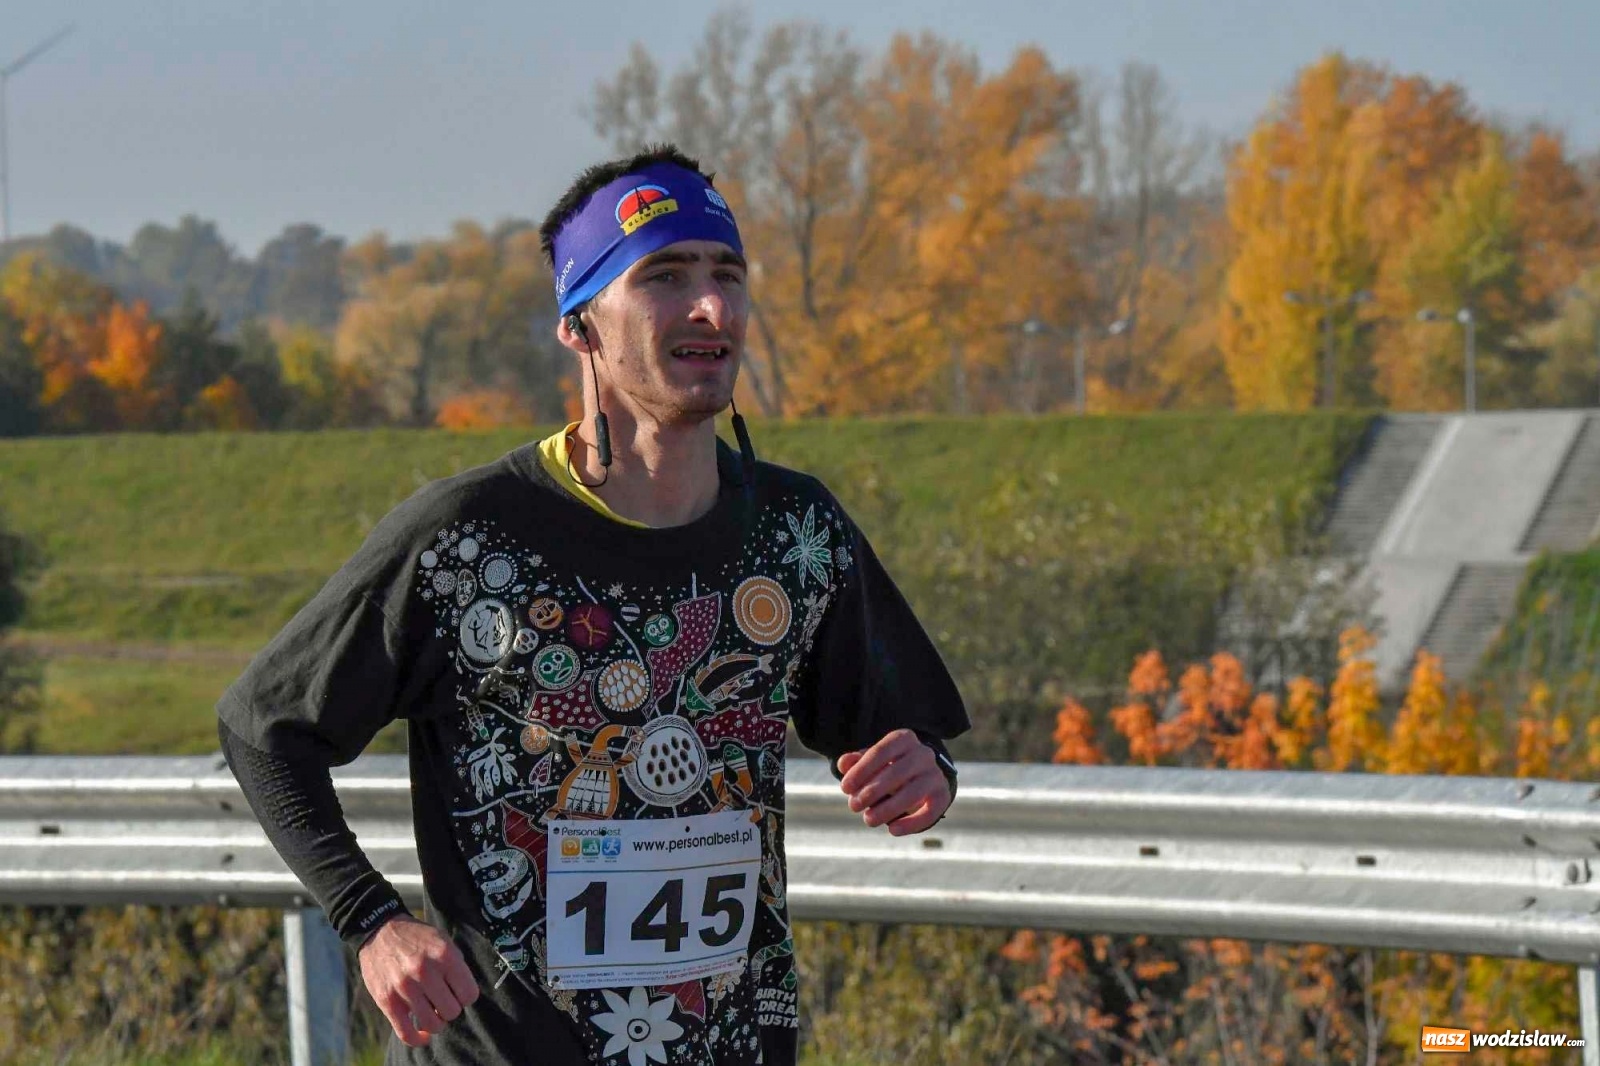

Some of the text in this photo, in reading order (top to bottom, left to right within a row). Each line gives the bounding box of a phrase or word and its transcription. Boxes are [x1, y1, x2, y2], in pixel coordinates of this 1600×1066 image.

[633, 828, 753, 852] www.personalbest.pl
[565, 872, 747, 956] 145
[755, 988, 796, 1003] BIRTH
